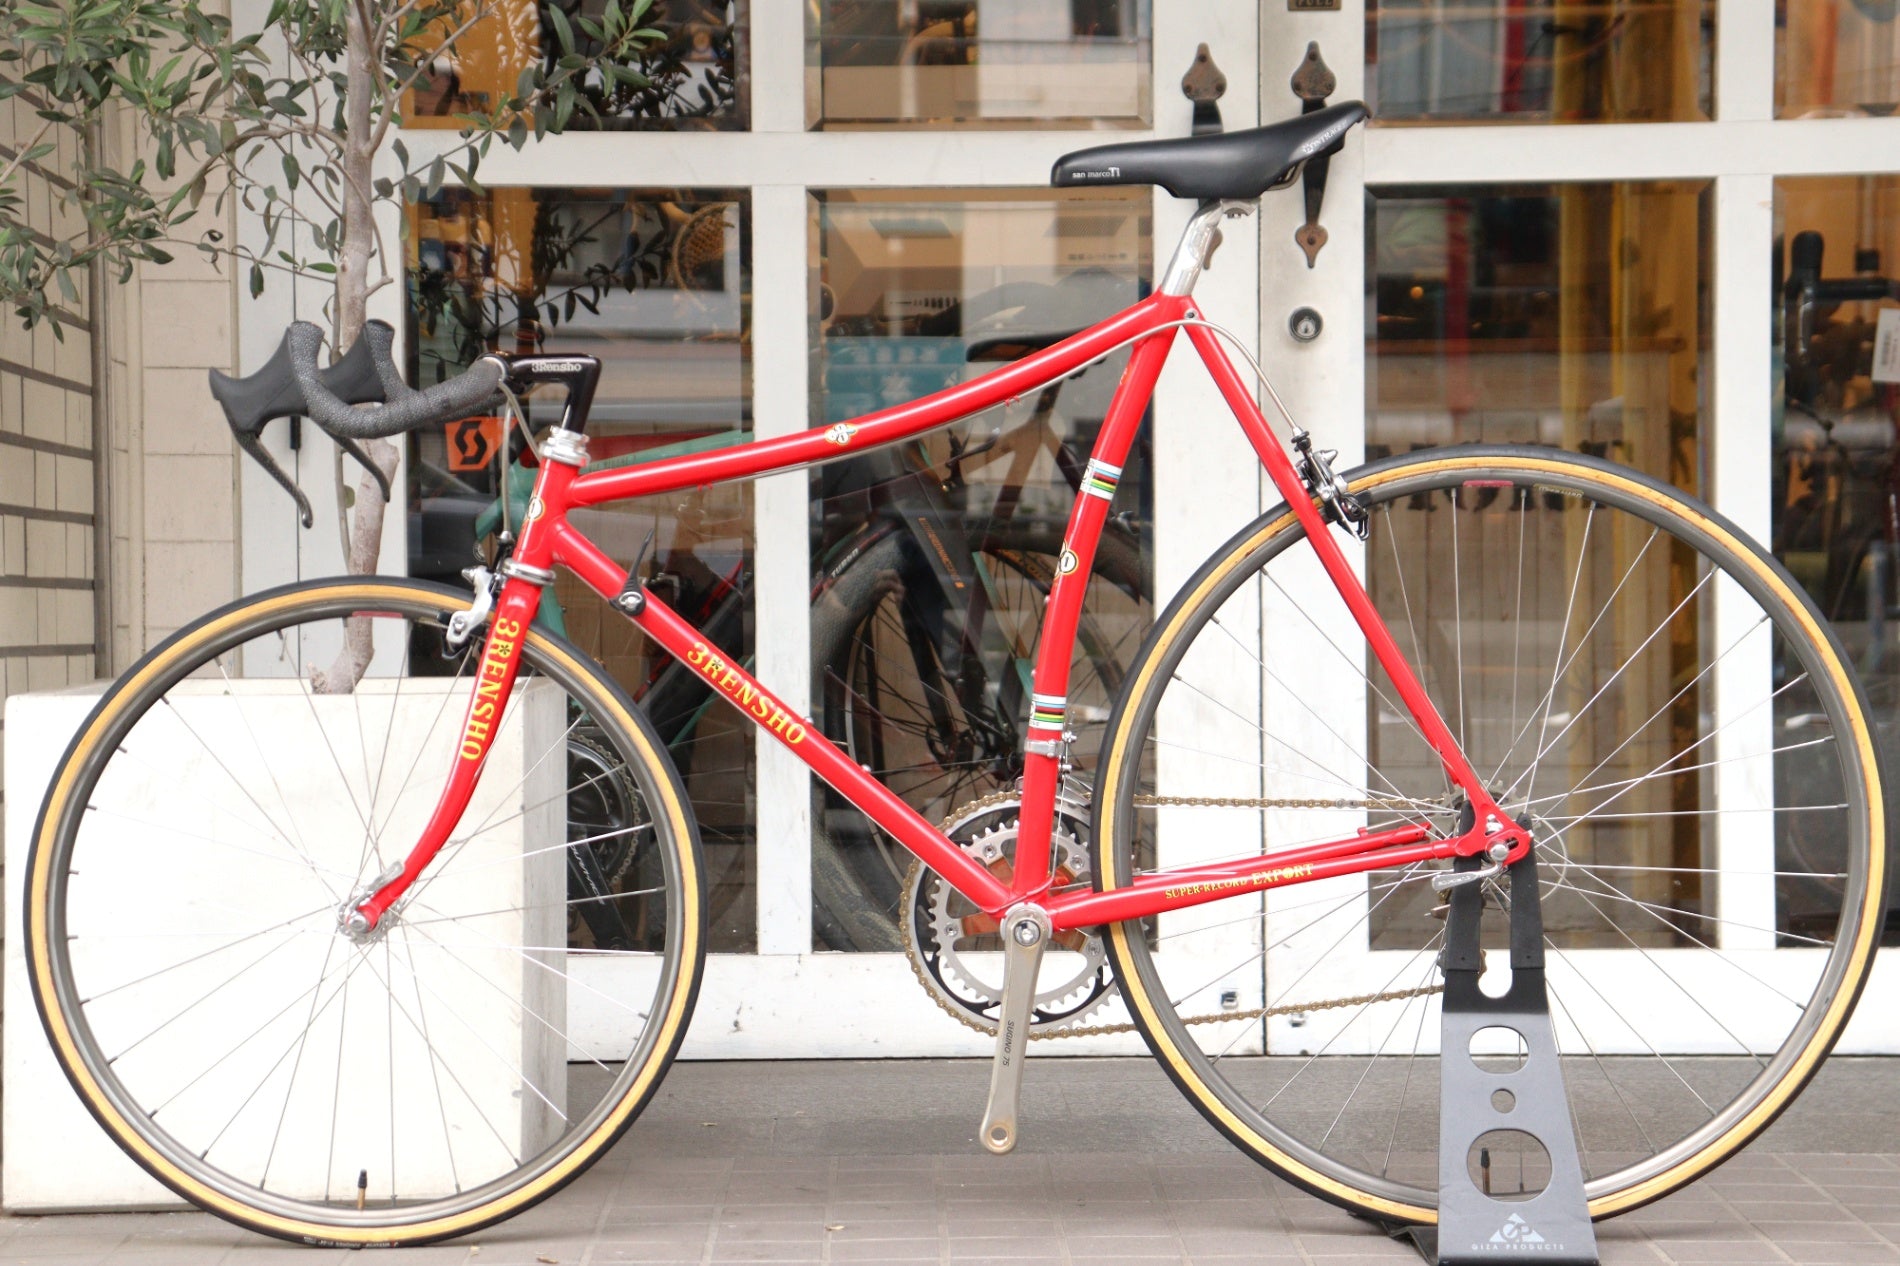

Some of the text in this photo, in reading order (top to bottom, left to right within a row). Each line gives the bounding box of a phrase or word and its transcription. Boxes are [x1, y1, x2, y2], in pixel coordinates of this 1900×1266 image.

[531, 361, 582, 373] 3Rensho
[460, 617, 520, 761] 3RENSHO
[687, 641, 806, 745] 3RENSHO
[1250, 862, 1314, 885] EXPORT
[1004, 1019, 1015, 1054] SUGINO
